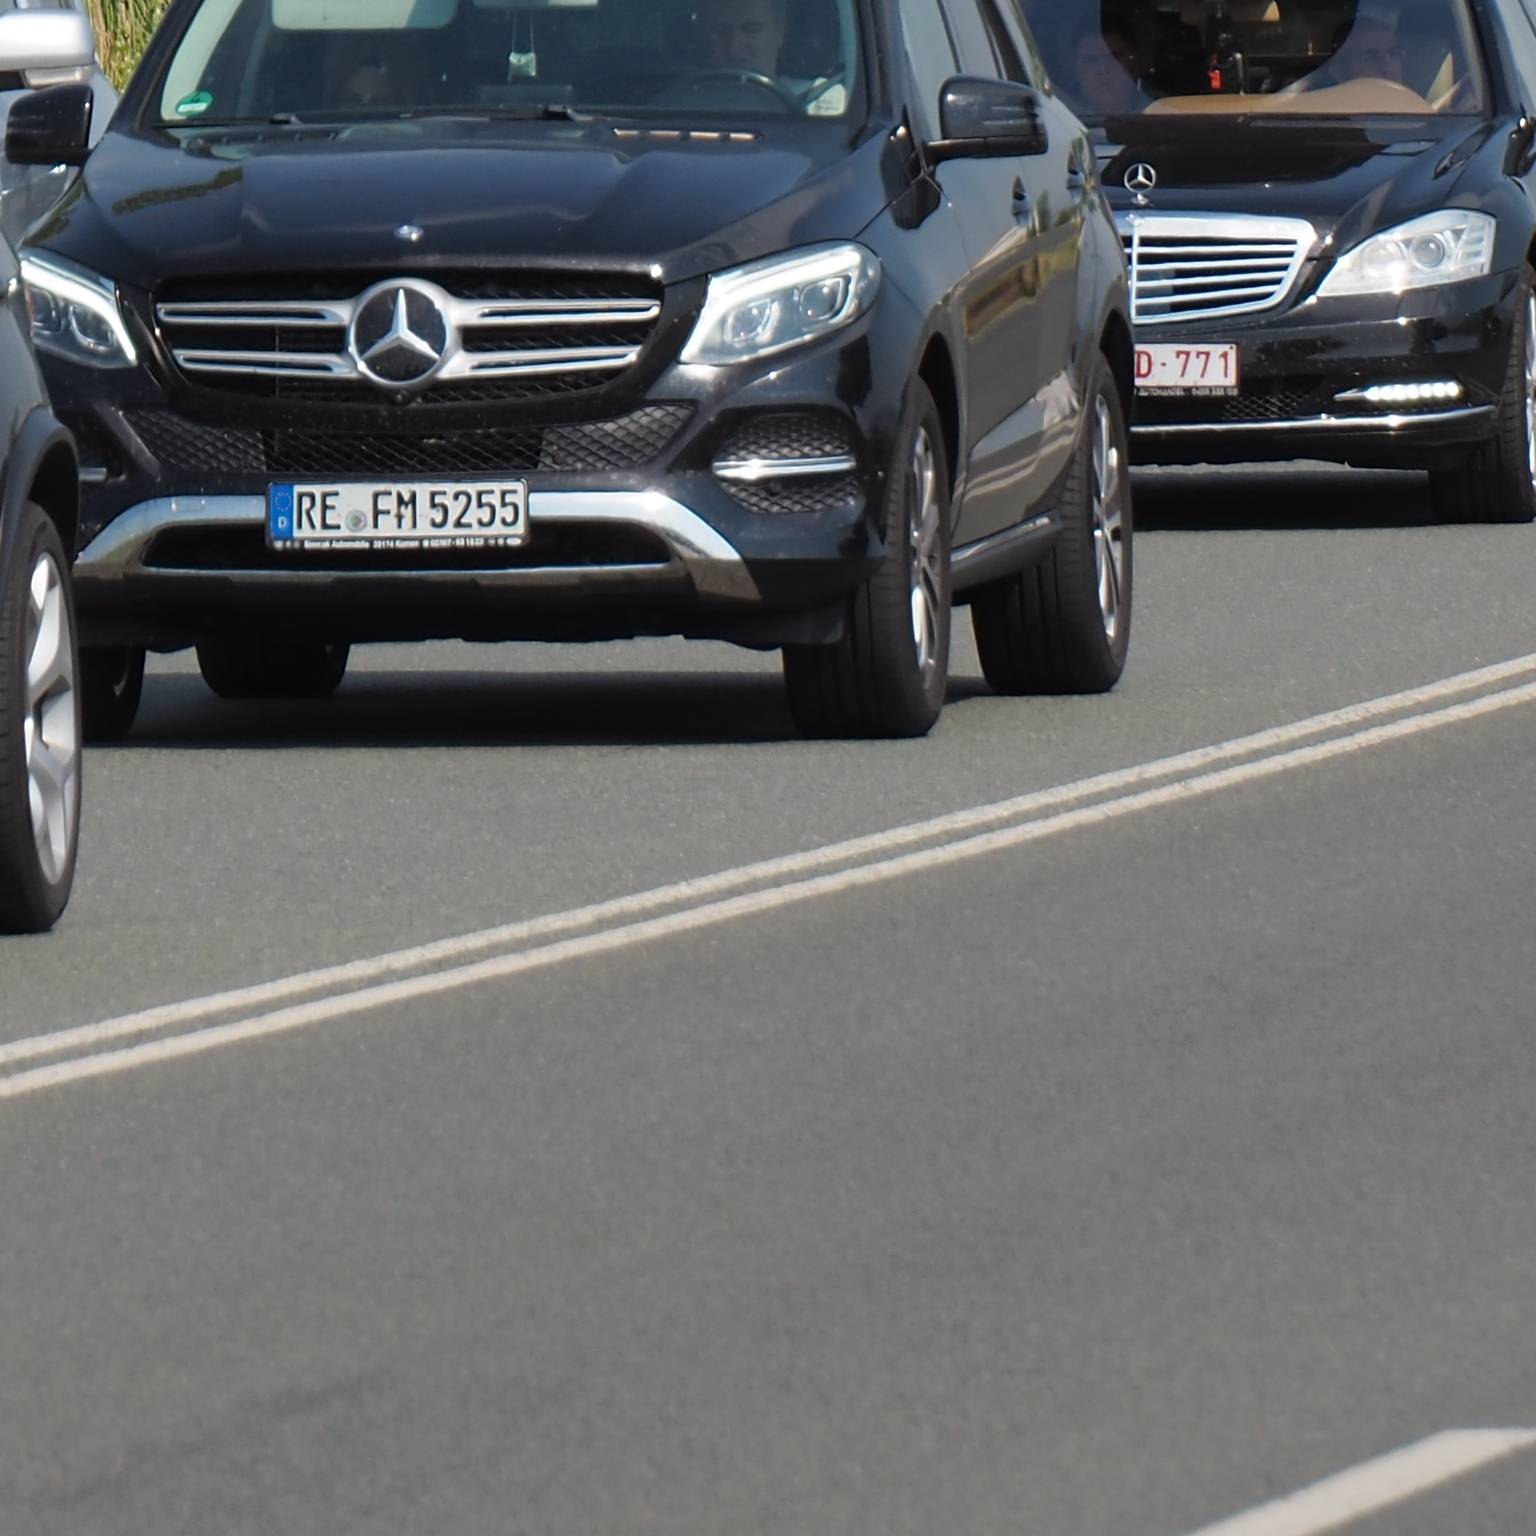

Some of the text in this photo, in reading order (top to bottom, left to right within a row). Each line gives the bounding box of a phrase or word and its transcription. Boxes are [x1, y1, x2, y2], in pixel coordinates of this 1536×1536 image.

[277, 489, 520, 531] D RE FM 5255
